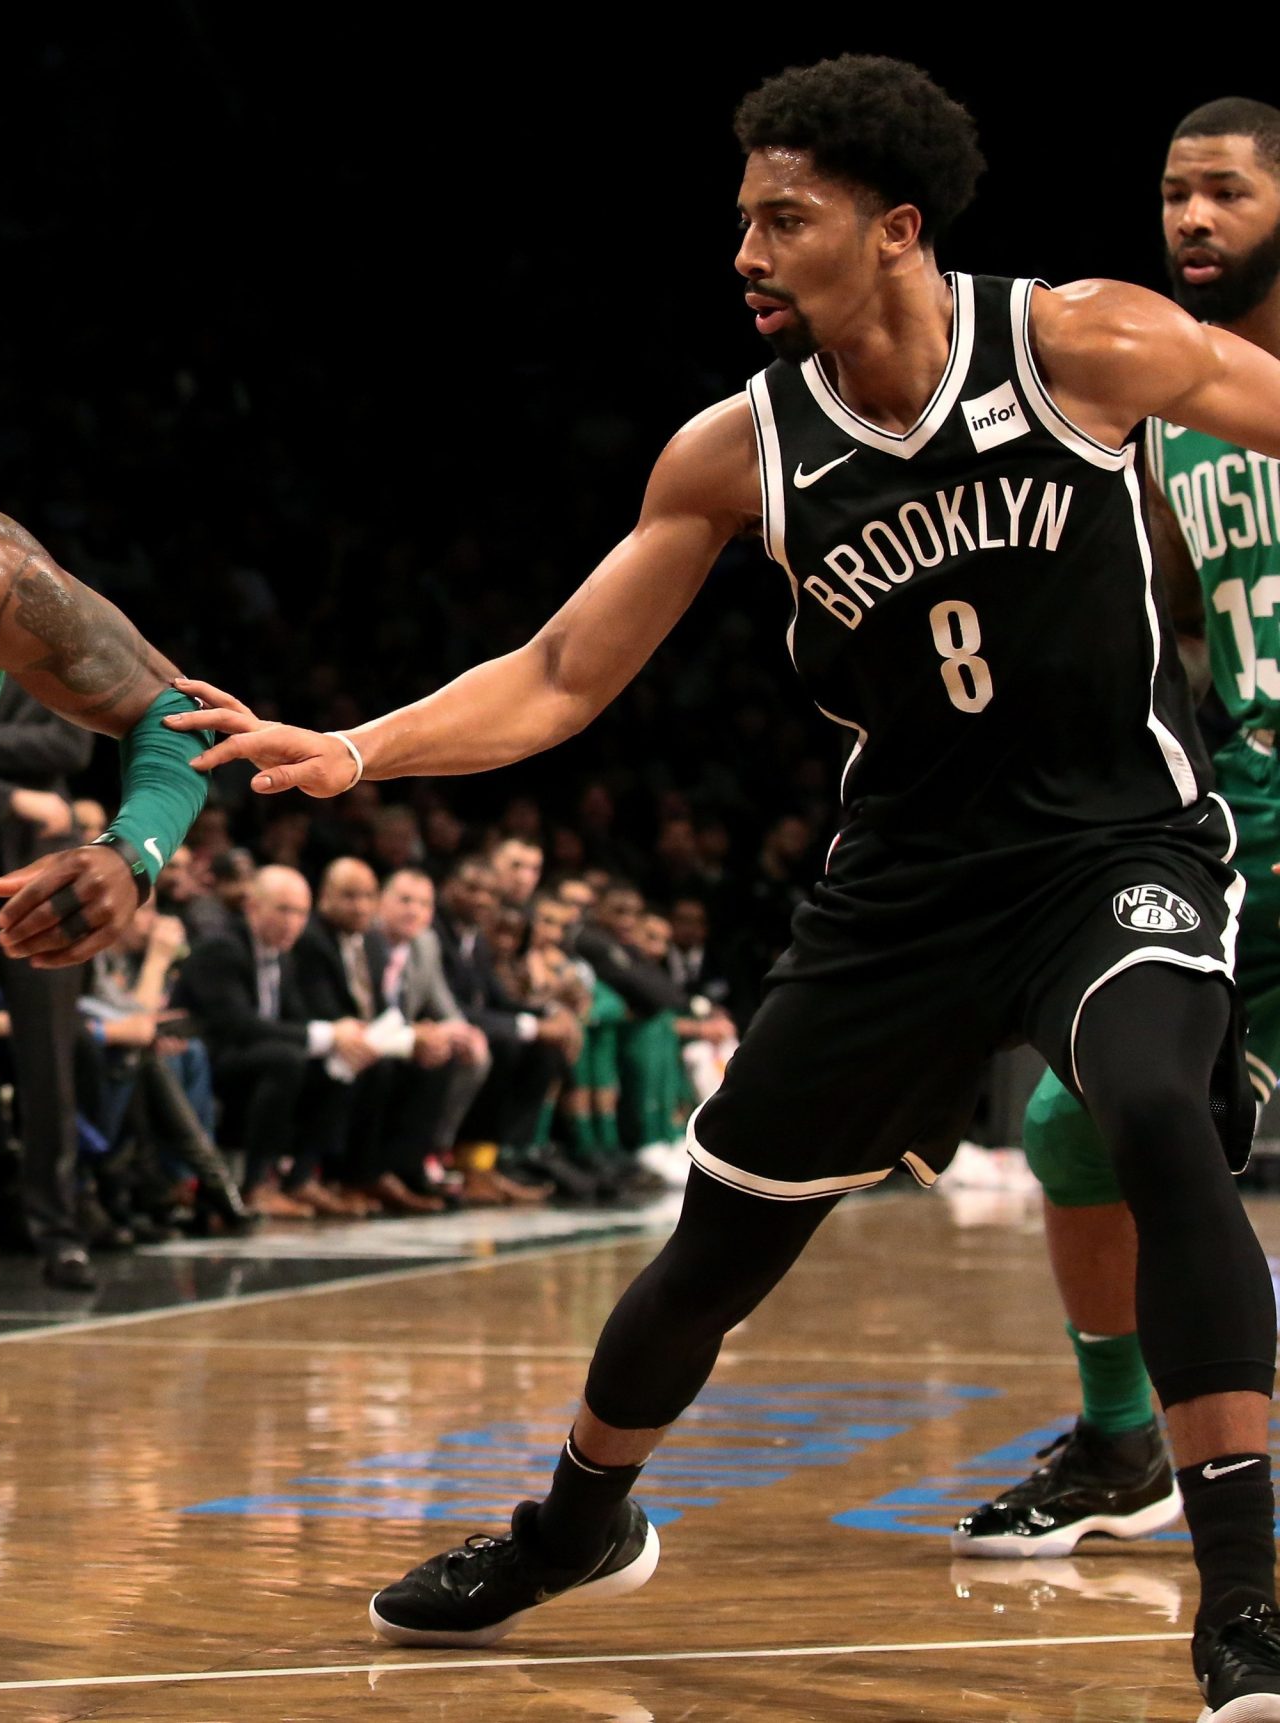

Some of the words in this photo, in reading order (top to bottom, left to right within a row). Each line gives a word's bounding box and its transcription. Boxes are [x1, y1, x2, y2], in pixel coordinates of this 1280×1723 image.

[970, 401, 1017, 432] infor
[803, 477, 1074, 631] BROOKLYN
[928, 600, 994, 714] 8
[1117, 886, 1196, 927] NETS
[1146, 907, 1162, 926] B
